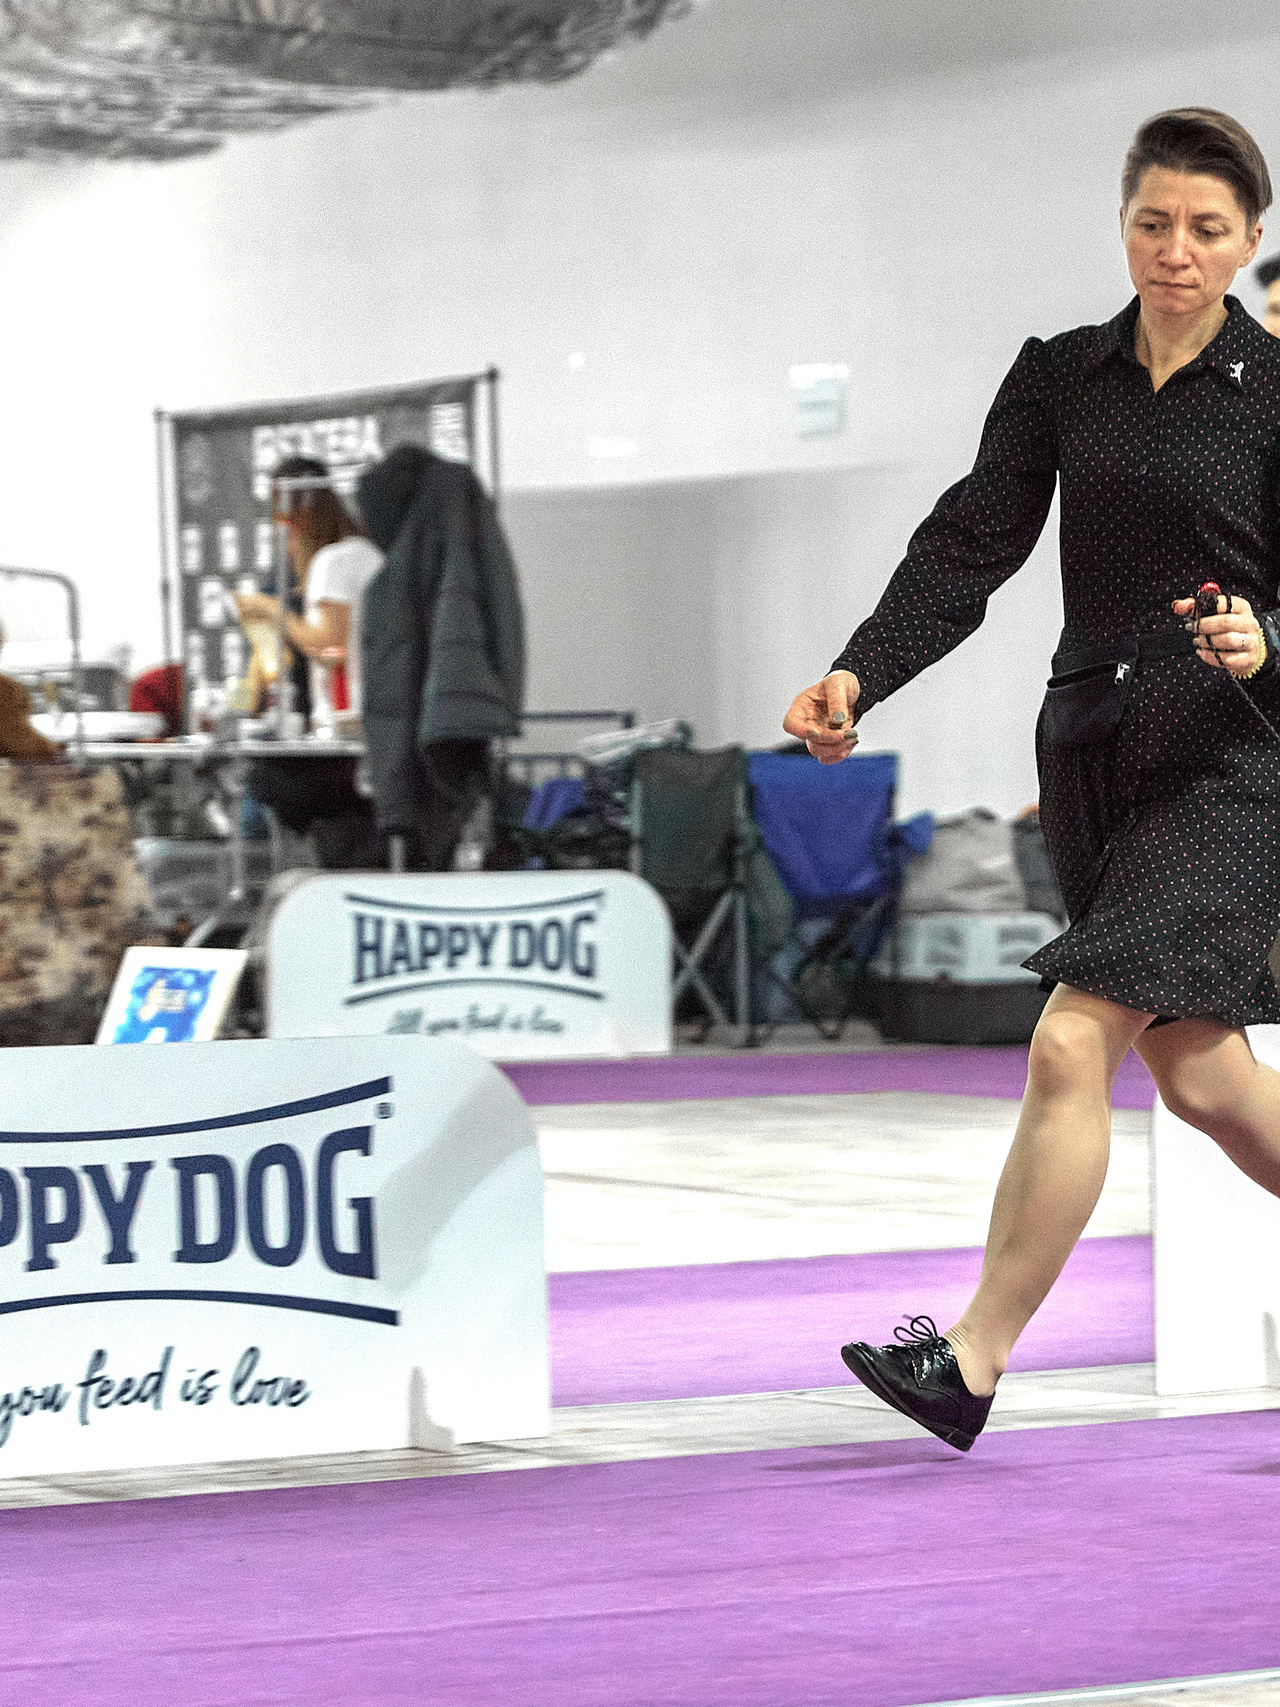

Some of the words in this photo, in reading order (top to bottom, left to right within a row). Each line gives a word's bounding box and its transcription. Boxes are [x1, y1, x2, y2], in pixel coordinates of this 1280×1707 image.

[352, 913, 499, 985] HAPPY
[508, 911, 598, 979] DOG
[168, 1125, 380, 1280] DOG
[75, 1345, 176, 1426] feed
[179, 1368, 221, 1406] is
[229, 1345, 314, 1408] love
